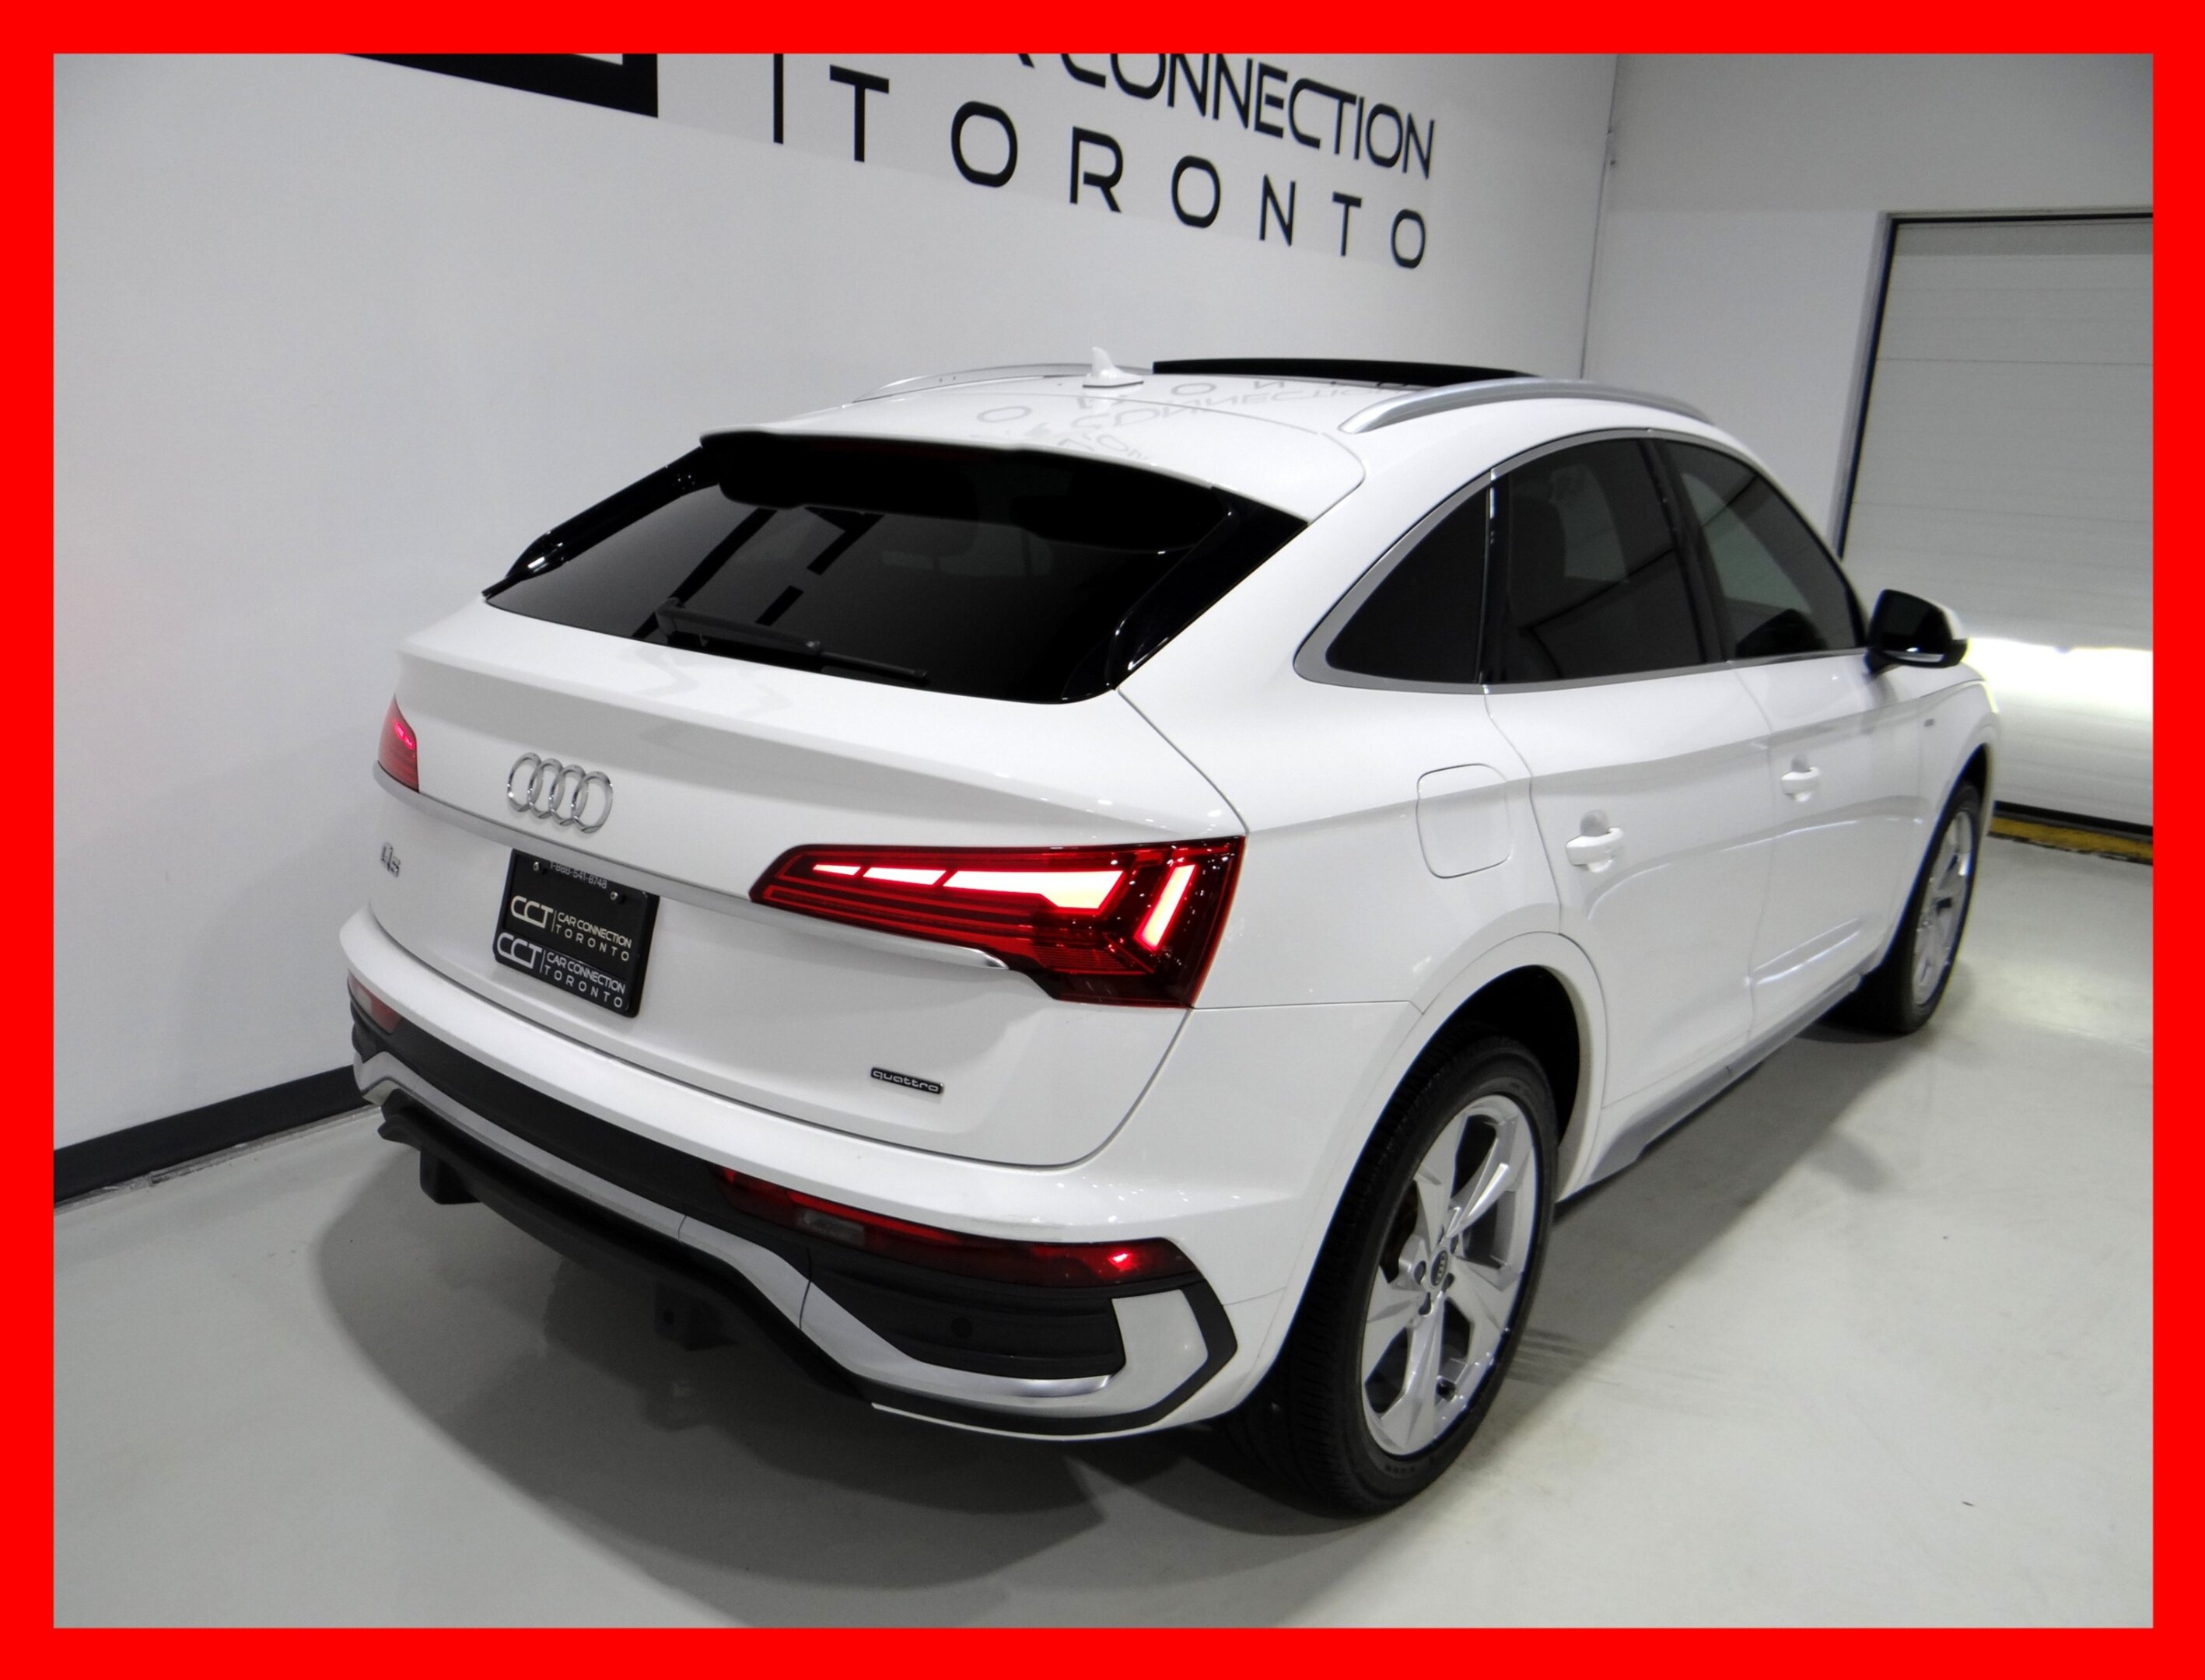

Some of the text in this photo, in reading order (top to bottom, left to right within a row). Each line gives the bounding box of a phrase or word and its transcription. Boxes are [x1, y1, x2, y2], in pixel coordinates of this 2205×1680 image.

[829, 65, 1426, 268] TORONTO
[510, 895, 554, 929] CCT
[558, 912, 632, 949] CAR CONNECTION
[497, 932, 542, 969] CCT
[555, 924, 629, 961] TORONTO
[544, 964, 623, 1008] TORONTO
[547, 951, 625, 995] CAR CONNECTION
[873, 1069, 939, 1093] quattro
